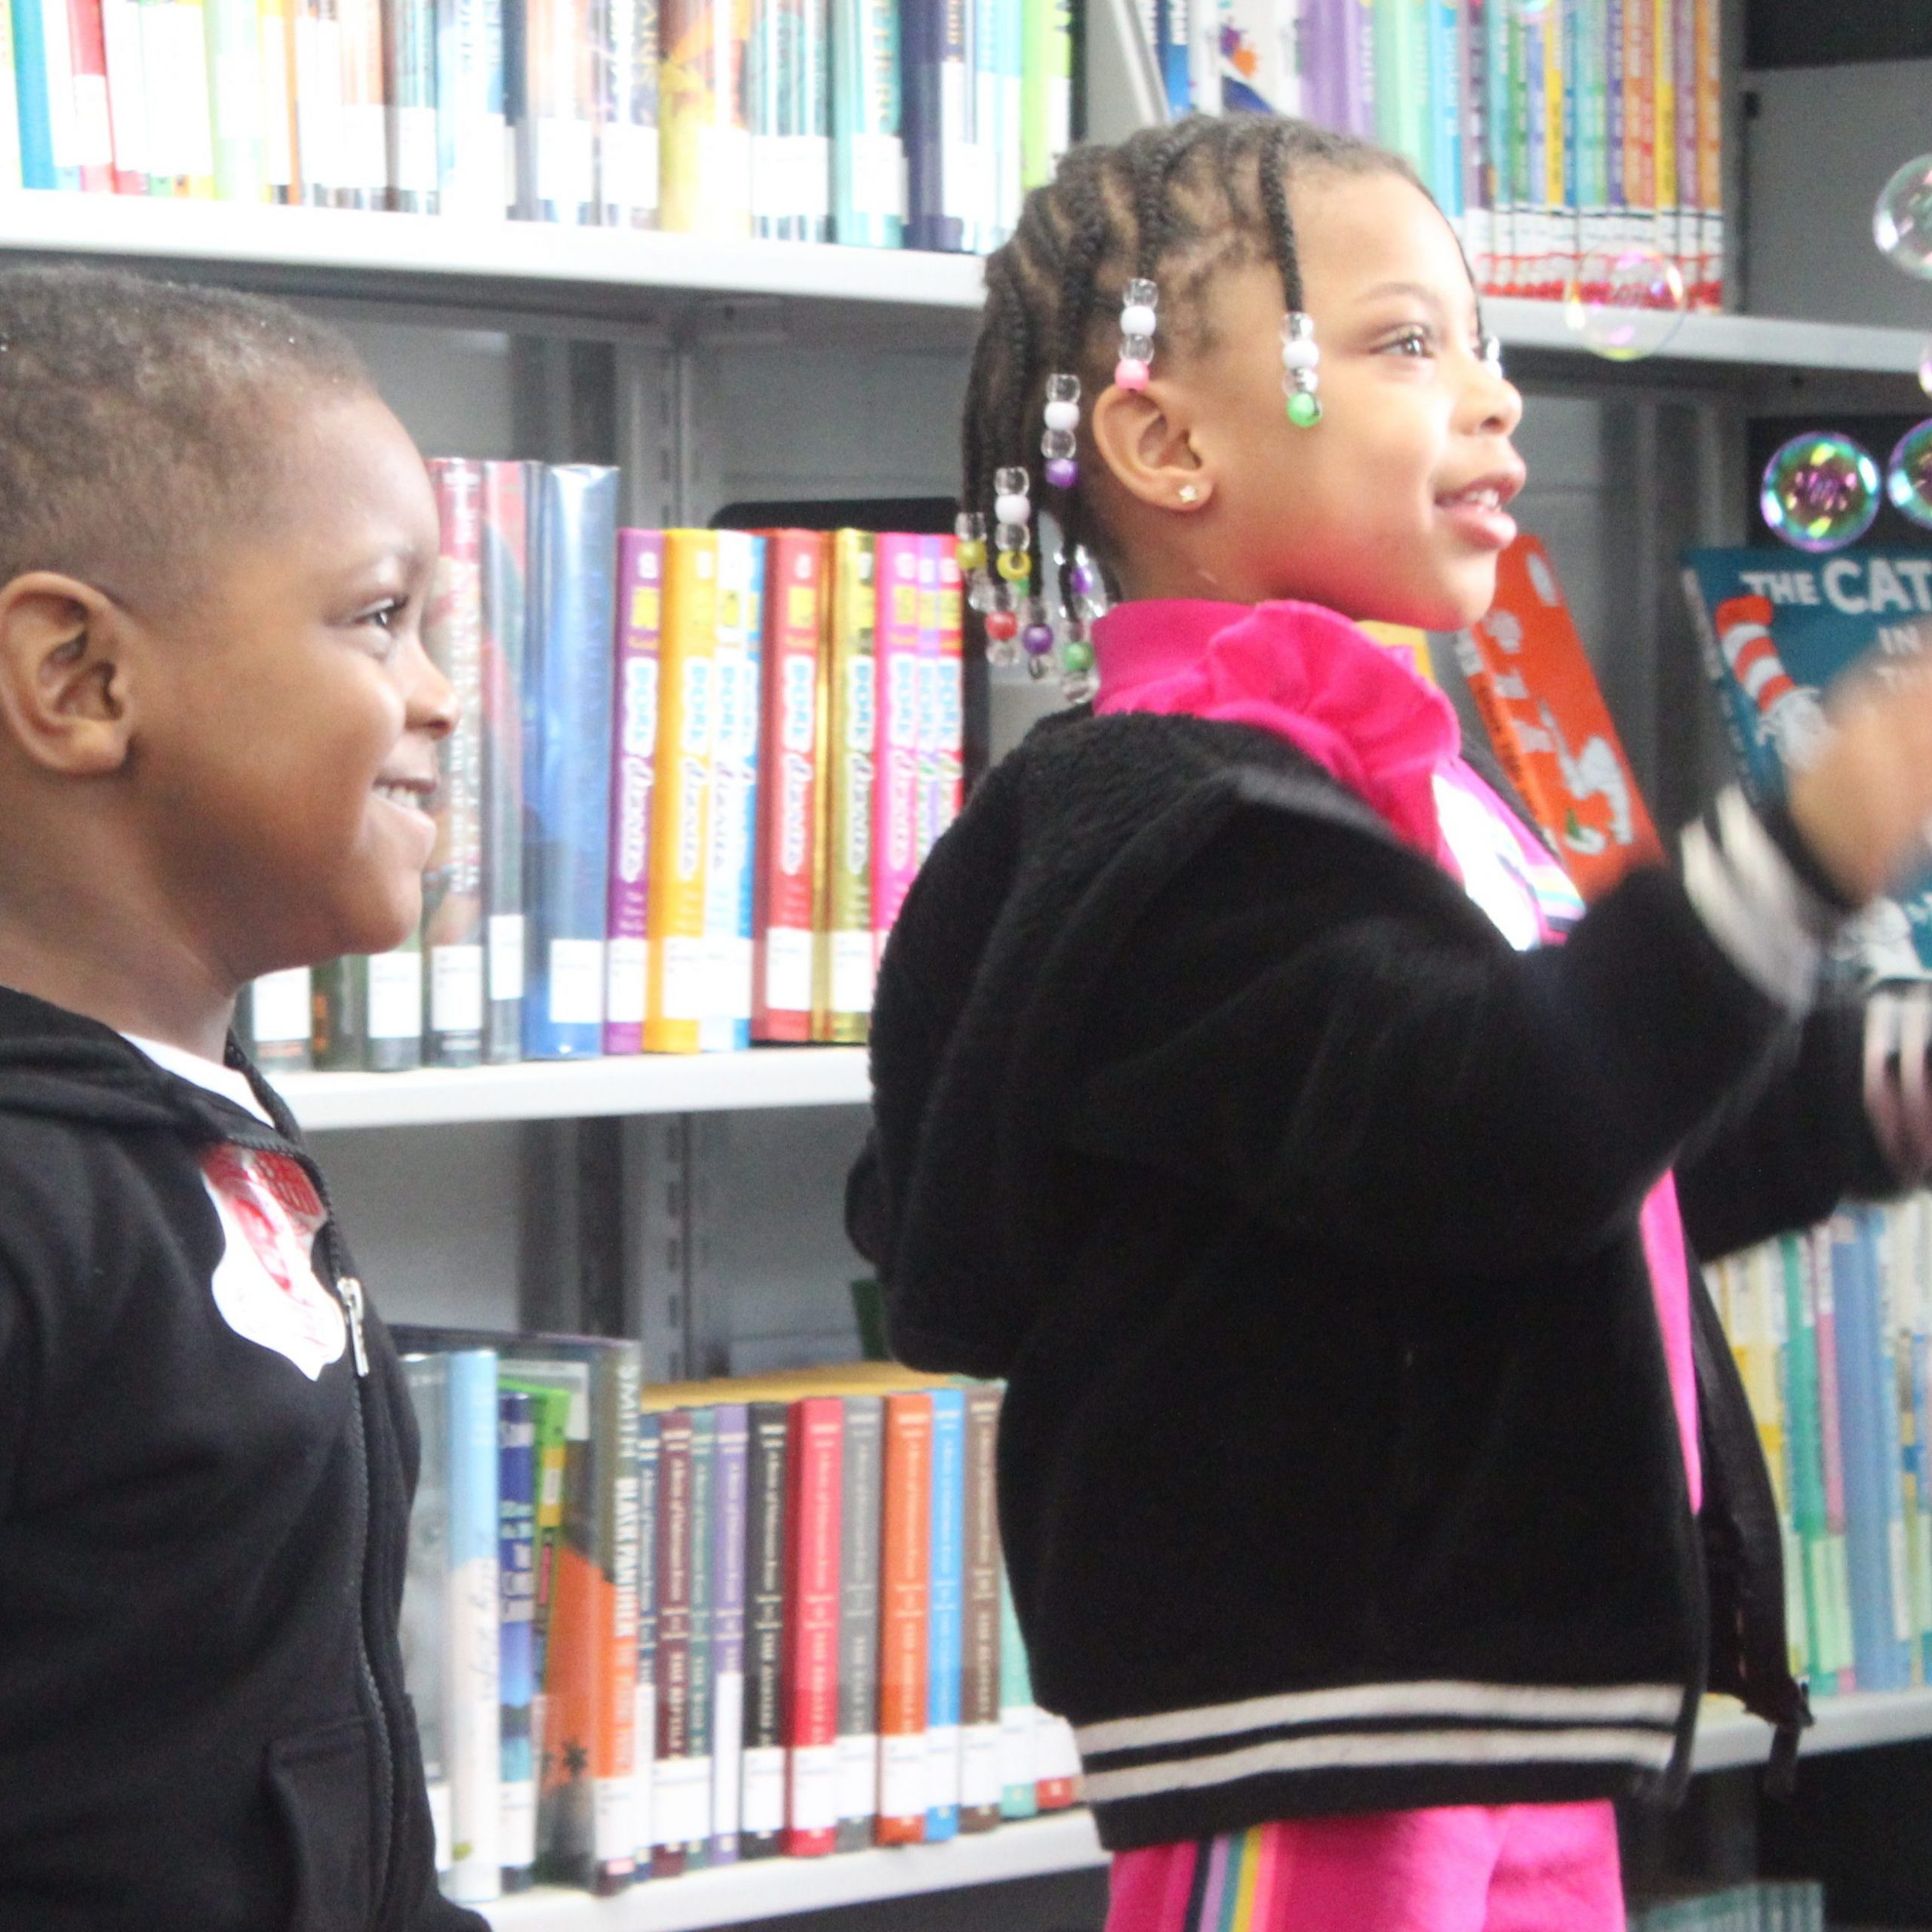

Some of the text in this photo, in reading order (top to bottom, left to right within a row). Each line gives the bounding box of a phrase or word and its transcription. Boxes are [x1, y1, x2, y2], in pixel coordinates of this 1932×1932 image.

[1740, 558, 1932, 614] THE CAT
[1878, 626, 1924, 654] IN
[617, 1363, 641, 1459] SMITH
